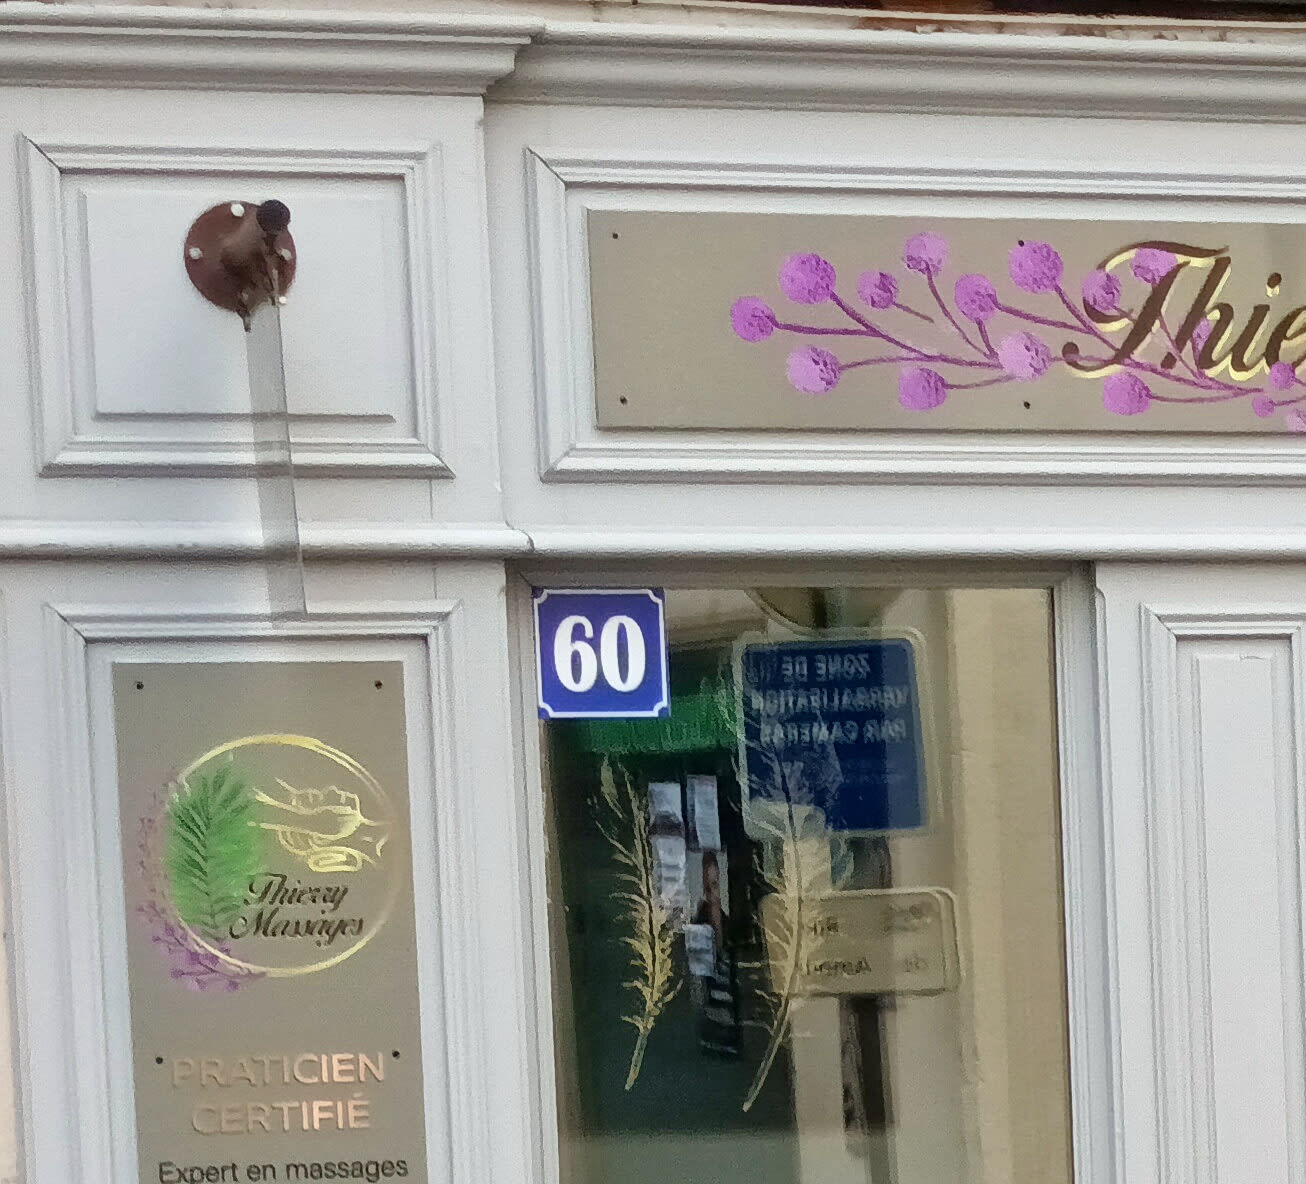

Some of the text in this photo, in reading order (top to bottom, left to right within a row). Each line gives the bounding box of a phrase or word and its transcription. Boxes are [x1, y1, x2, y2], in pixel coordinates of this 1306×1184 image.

[553, 615, 646, 693] 60
[243, 872, 349, 913] Thierry
[228, 907, 364, 947] Massages
[170, 1052, 385, 1089] PRATICIEN
[192, 1092, 371, 1136] CERTIFIÉ
[246, 1163, 276, 1182] en
[286, 1158, 409, 1183] massages
